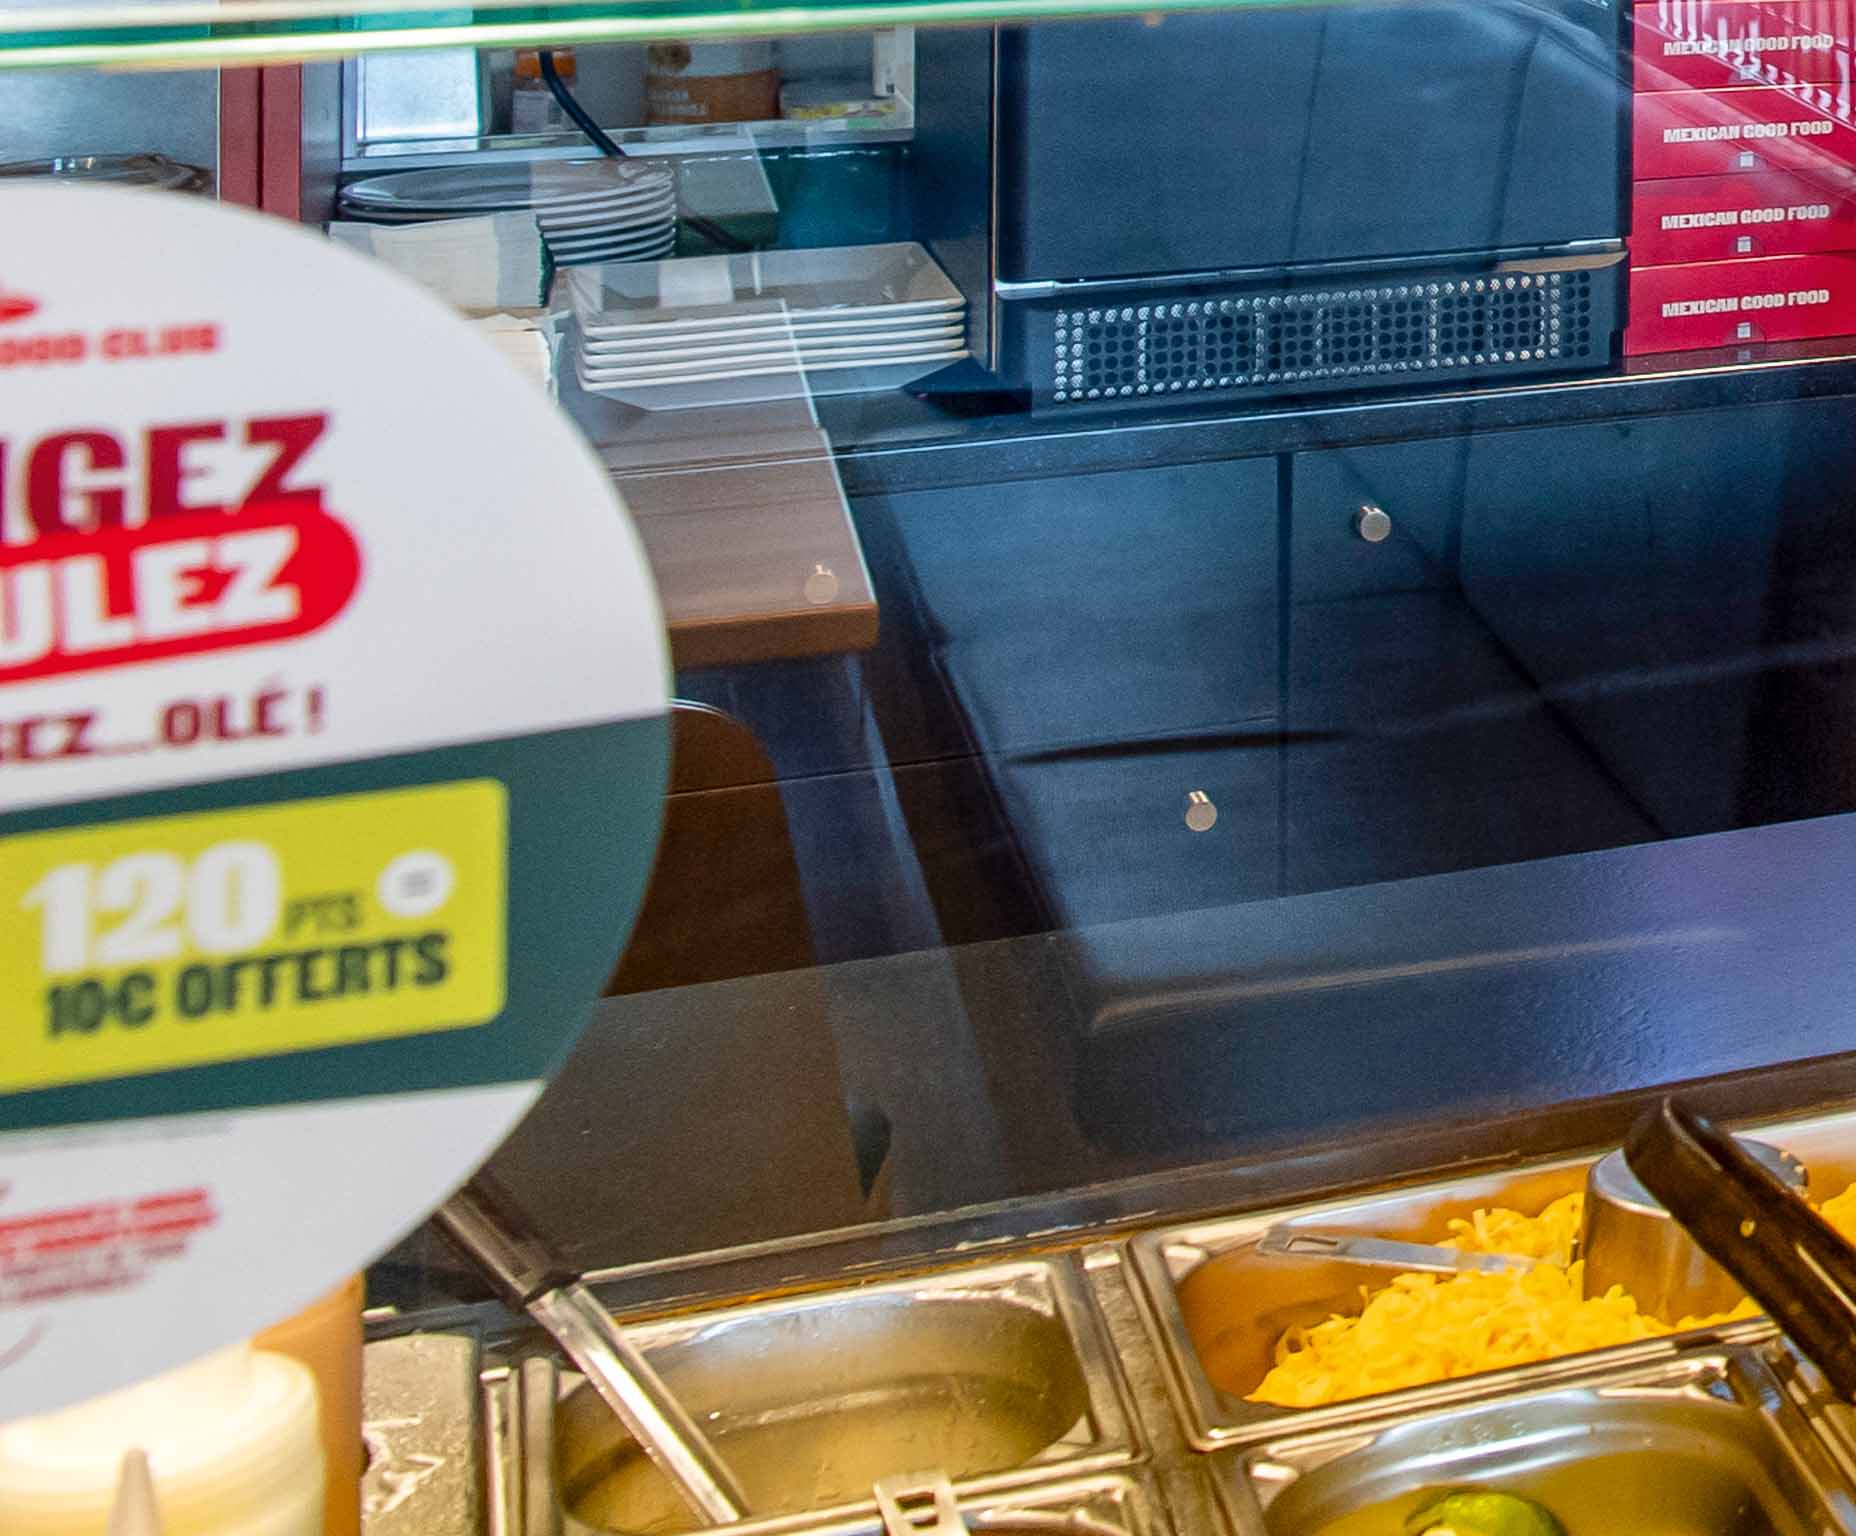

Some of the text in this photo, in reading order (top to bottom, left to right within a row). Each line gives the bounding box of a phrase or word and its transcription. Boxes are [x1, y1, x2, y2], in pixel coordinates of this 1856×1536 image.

[1791, 35, 1834, 50] FOOD
[1664, 121, 1832, 143] MEXICAN GOOD FOOD
[1661, 205, 1830, 230] MEXICAN GOOD FOOD
[1662, 289, 1829, 318] MEXICAN GOOD FOOD
[21, 839, 282, 974] 120
[177, 932, 450, 1018] OFFERTS
